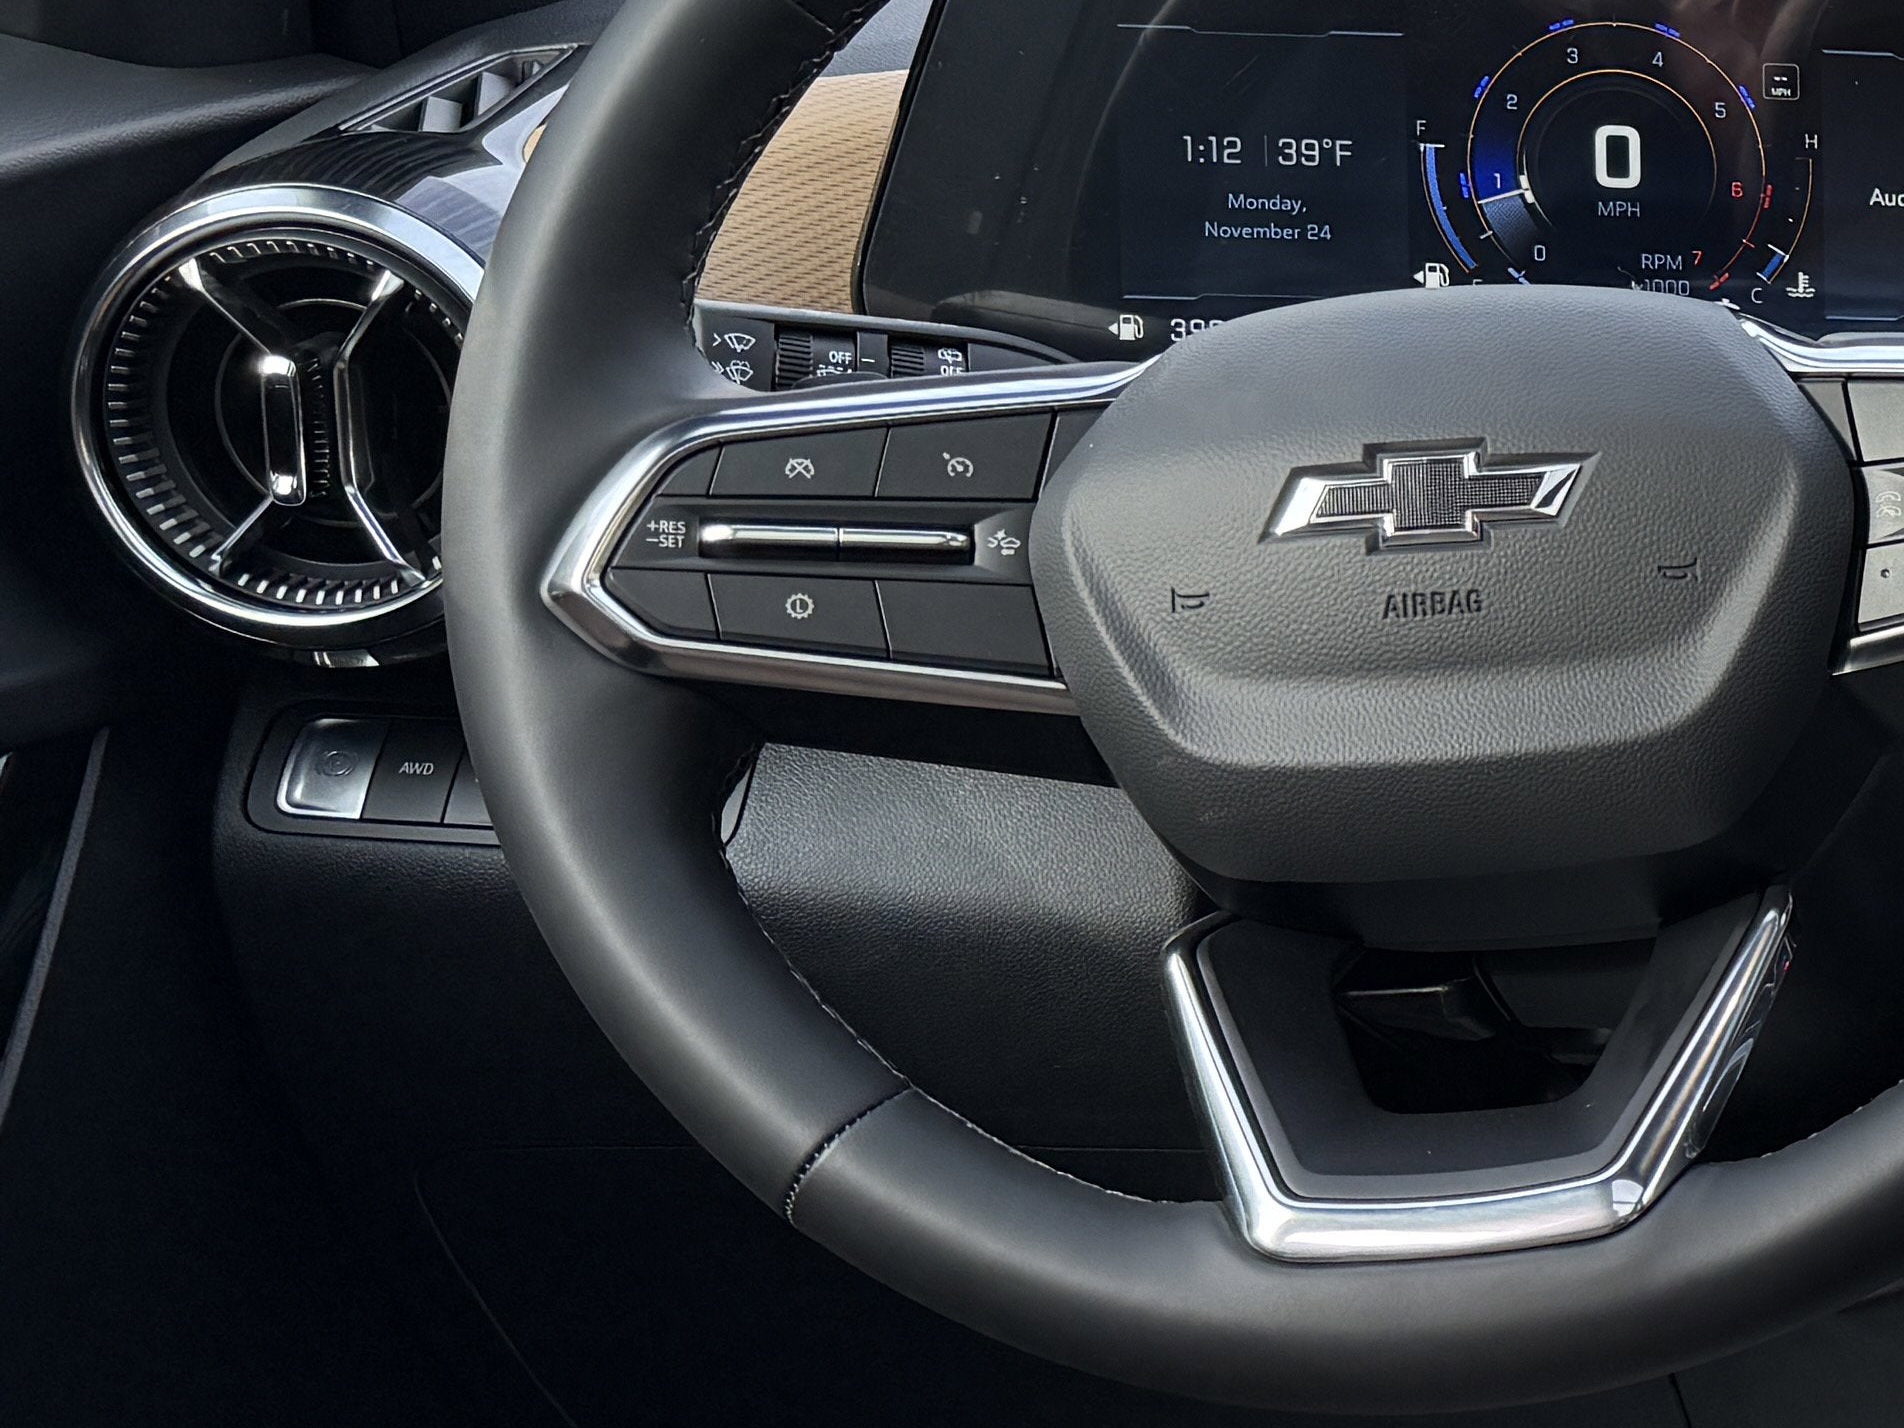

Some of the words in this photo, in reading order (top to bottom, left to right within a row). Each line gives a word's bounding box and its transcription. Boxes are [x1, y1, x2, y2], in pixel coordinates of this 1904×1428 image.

[1566, 47, 1579, 65] 3
[1651, 51, 1664, 68] 4
[1506, 94, 1518, 110] 2
[1714, 102, 1727, 119] 5
[1416, 119, 1427, 137] F
[1804, 133, 1818, 149] H
[1182, 135, 1242, 164] 1:12
[1278, 137, 1353, 167] 39°F
[1594, 123, 1642, 189] 0
[1494, 172, 1502, 190] 1
[1731, 181, 1744, 199] 6
[1228, 193, 1307, 216] Monday,
[1597, 201, 1641, 218] MPH
[1205, 220, 1301, 240] November
[1307, 224, 1332, 240] 24
[1534, 244, 1546, 262] 0
[1641, 253, 1683, 271] RPM
[1691, 250, 1703, 266] 7
[1751, 287, 1763, 304] C
[829, 350, 852, 364] OFF
[1382, 589, 1483, 620] AIRBAG
[399, 762, 434, 776] AWD
